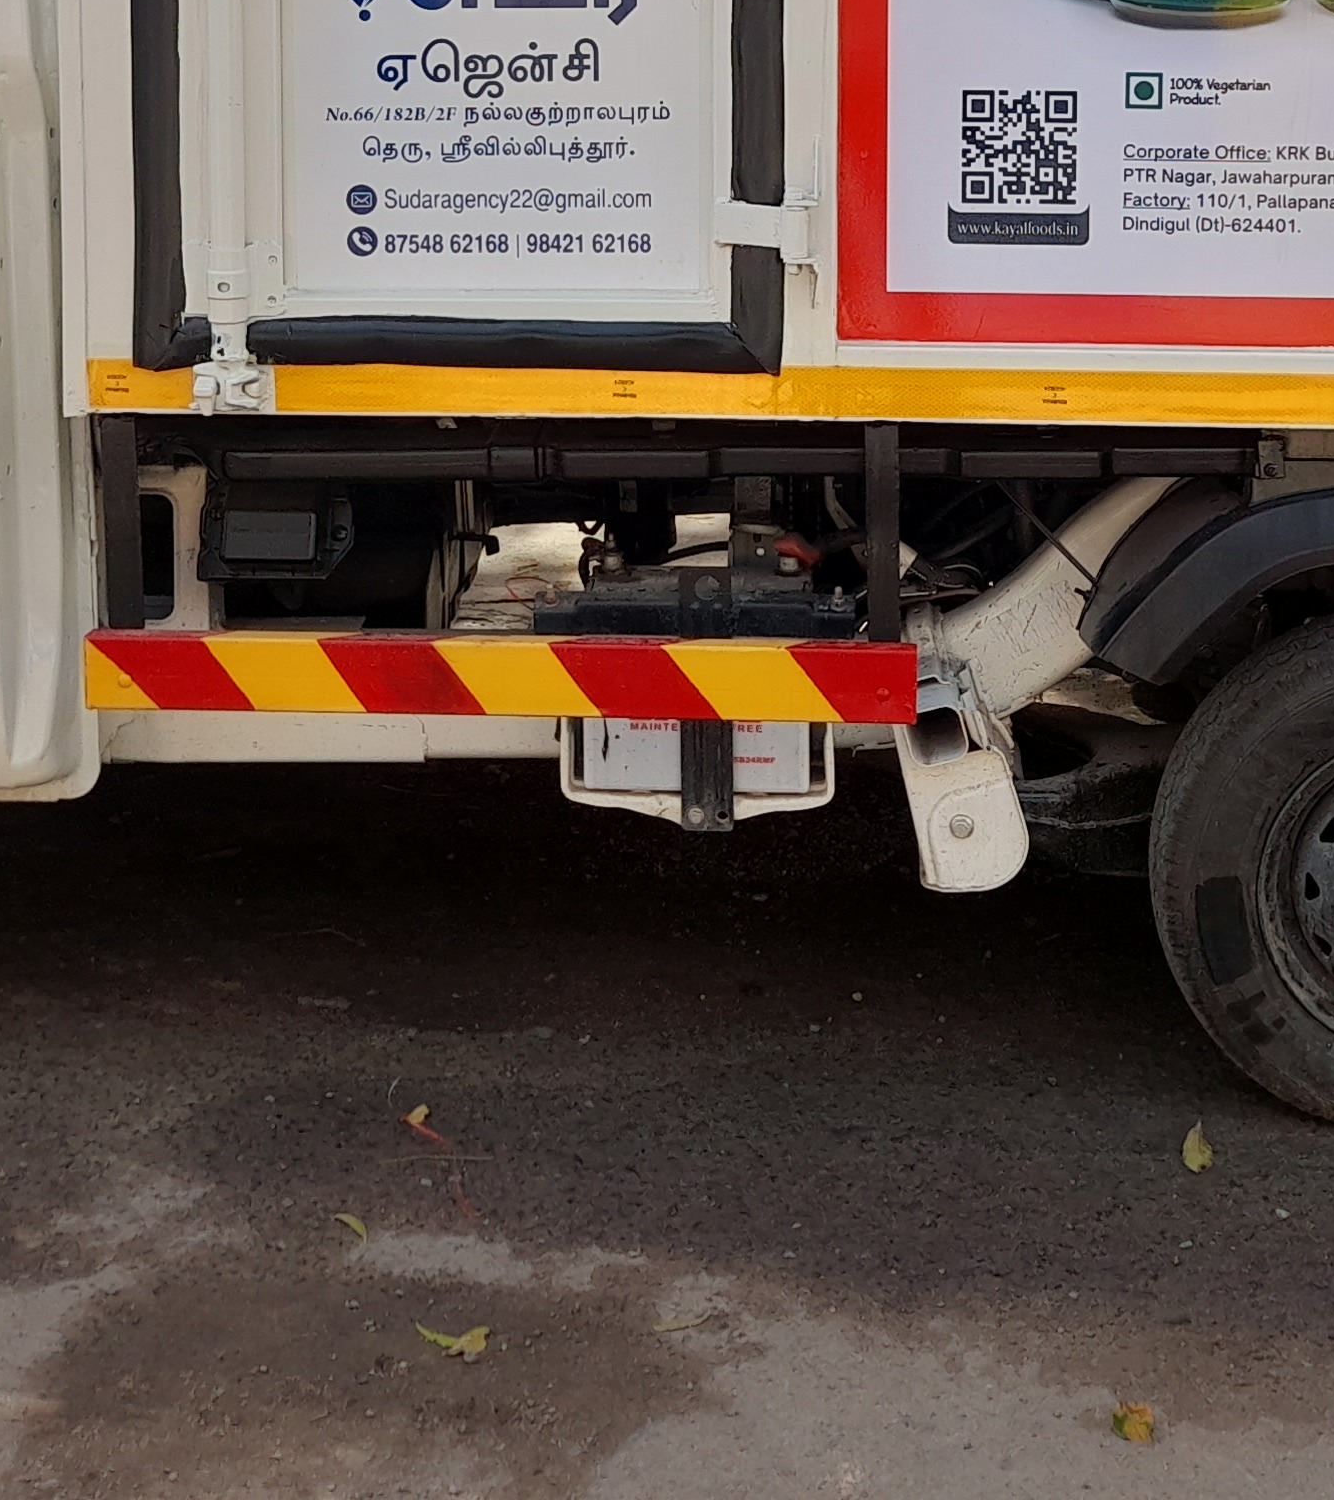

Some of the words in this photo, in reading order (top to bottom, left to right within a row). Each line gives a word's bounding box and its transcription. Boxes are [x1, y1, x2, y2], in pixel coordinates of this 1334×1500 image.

[377, 38, 600, 99] ஏஜென்சி
[1169, 78, 1202, 91] 100%
[1206, 78, 1271, 94] Vegetarian
[325, 105, 457, 123] No.66/182B/2F
[463, 101, 670, 127] நல்லகுற்றாலபுரம்
[362, 136, 432, 162] தெரு,
[1123, 144, 1210, 162] Corporate
[1214, 144, 1271, 162] Office:
[1275, 146, 1310, 161] KRK
[1123, 168, 1156, 183] PTR
[1161, 169, 1215, 187] Nagar,
[384, 187, 652, 214] Sudaragency22@gmail.com
[1123, 192, 1191, 210] Factory:
[1196, 193, 1252, 210] 110/1,
[957, 220, 1079, 238] www.kayalfoods.in
[1123, 215, 1191, 236] Dindigul
[1195, 216, 1302, 235] (Dt)-624401.
[384, 234, 444, 255] 87548
[449, 234, 509, 255] 62168
[526, 234, 584, 255] 98421
[592, 234, 651, 255] 62168
